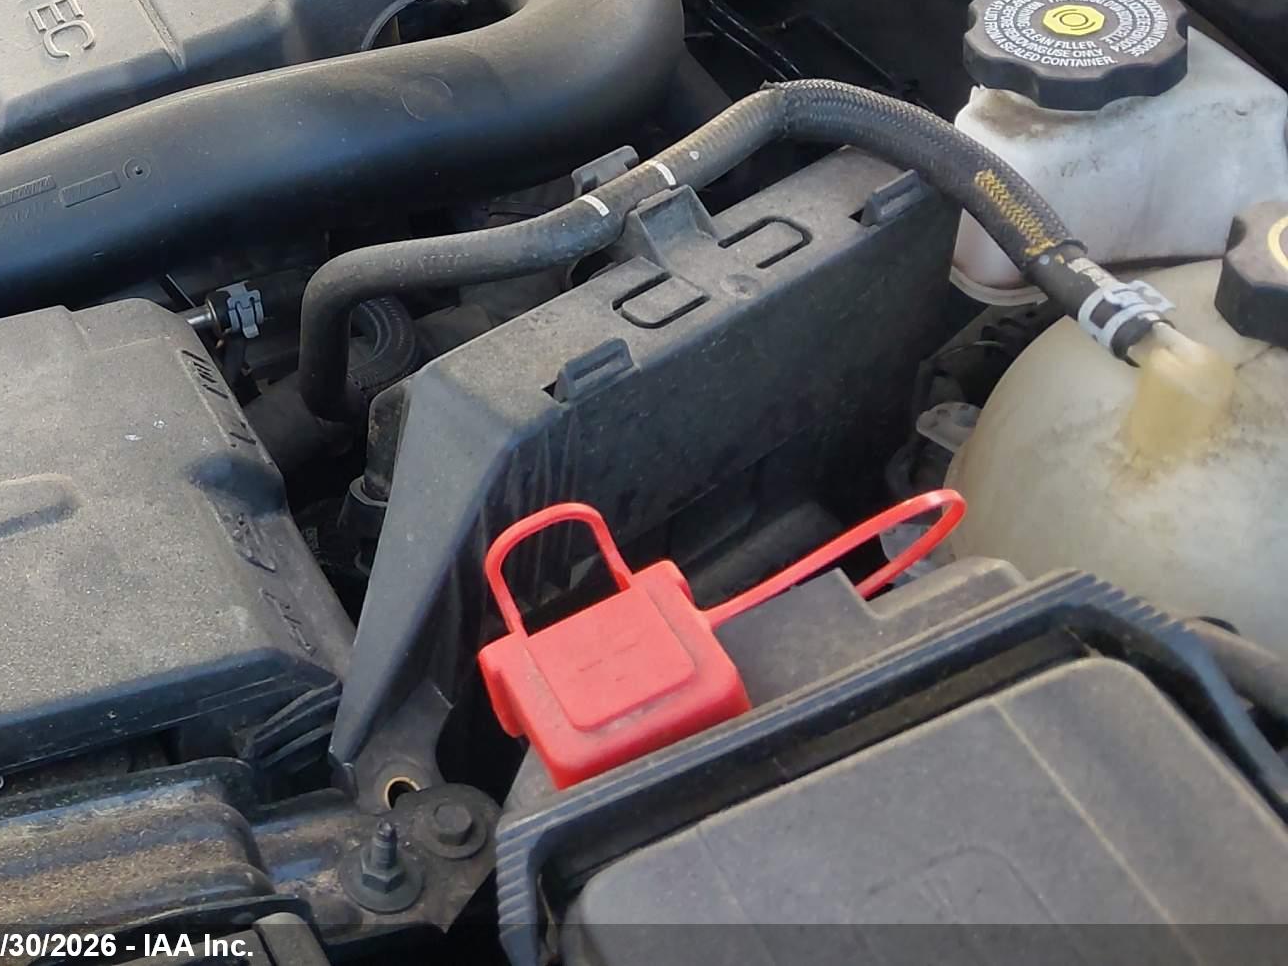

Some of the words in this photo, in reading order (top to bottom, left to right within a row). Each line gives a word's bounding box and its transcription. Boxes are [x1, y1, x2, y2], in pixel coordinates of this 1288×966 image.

[984, 3, 1002, 21] FLUID
[1000, 6, 1018, 28] BEFORE
[984, 21, 1000, 39] FROM
[1022, 28, 1053, 46] CLEAN
[1053, 40, 1097, 49] FILLER
[1003, 27, 1048, 54] REMOVING
[1000, 41, 1040, 61] SEALED
[1047, 48, 1070, 57] USE
[1072, 48, 1104, 57] ONLY
